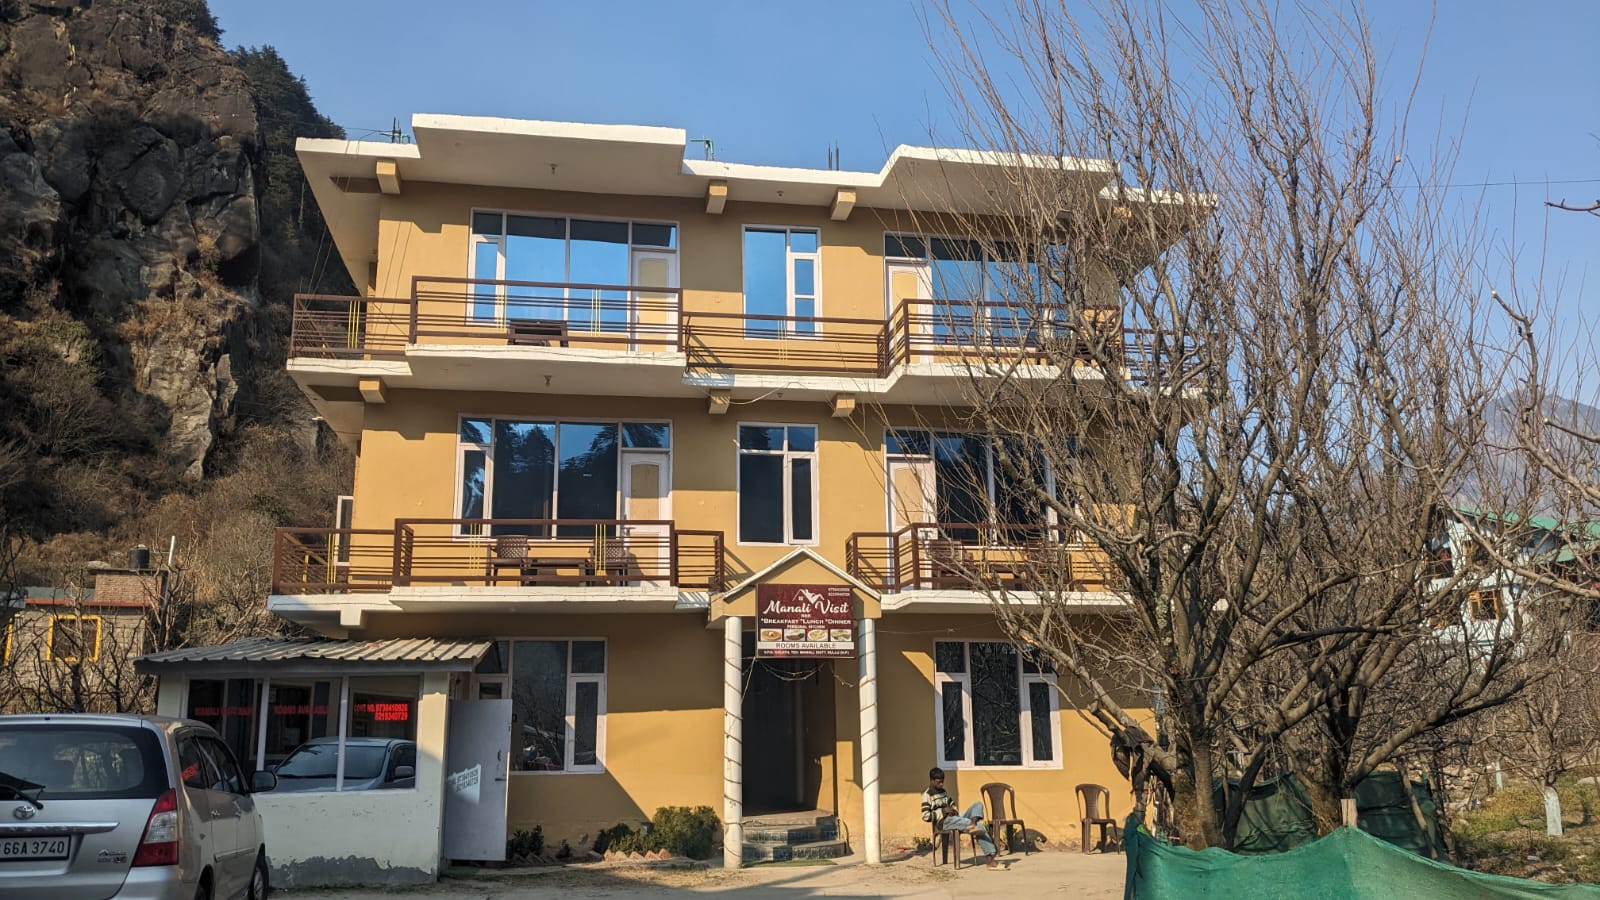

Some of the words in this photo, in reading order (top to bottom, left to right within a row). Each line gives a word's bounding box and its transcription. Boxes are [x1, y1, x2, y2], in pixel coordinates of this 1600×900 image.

[762, 600, 812, 614] Manali
[814, 599, 849, 615] Visit
[0, 841, 27, 855] 66A
[31, 840, 65, 854] 3740
